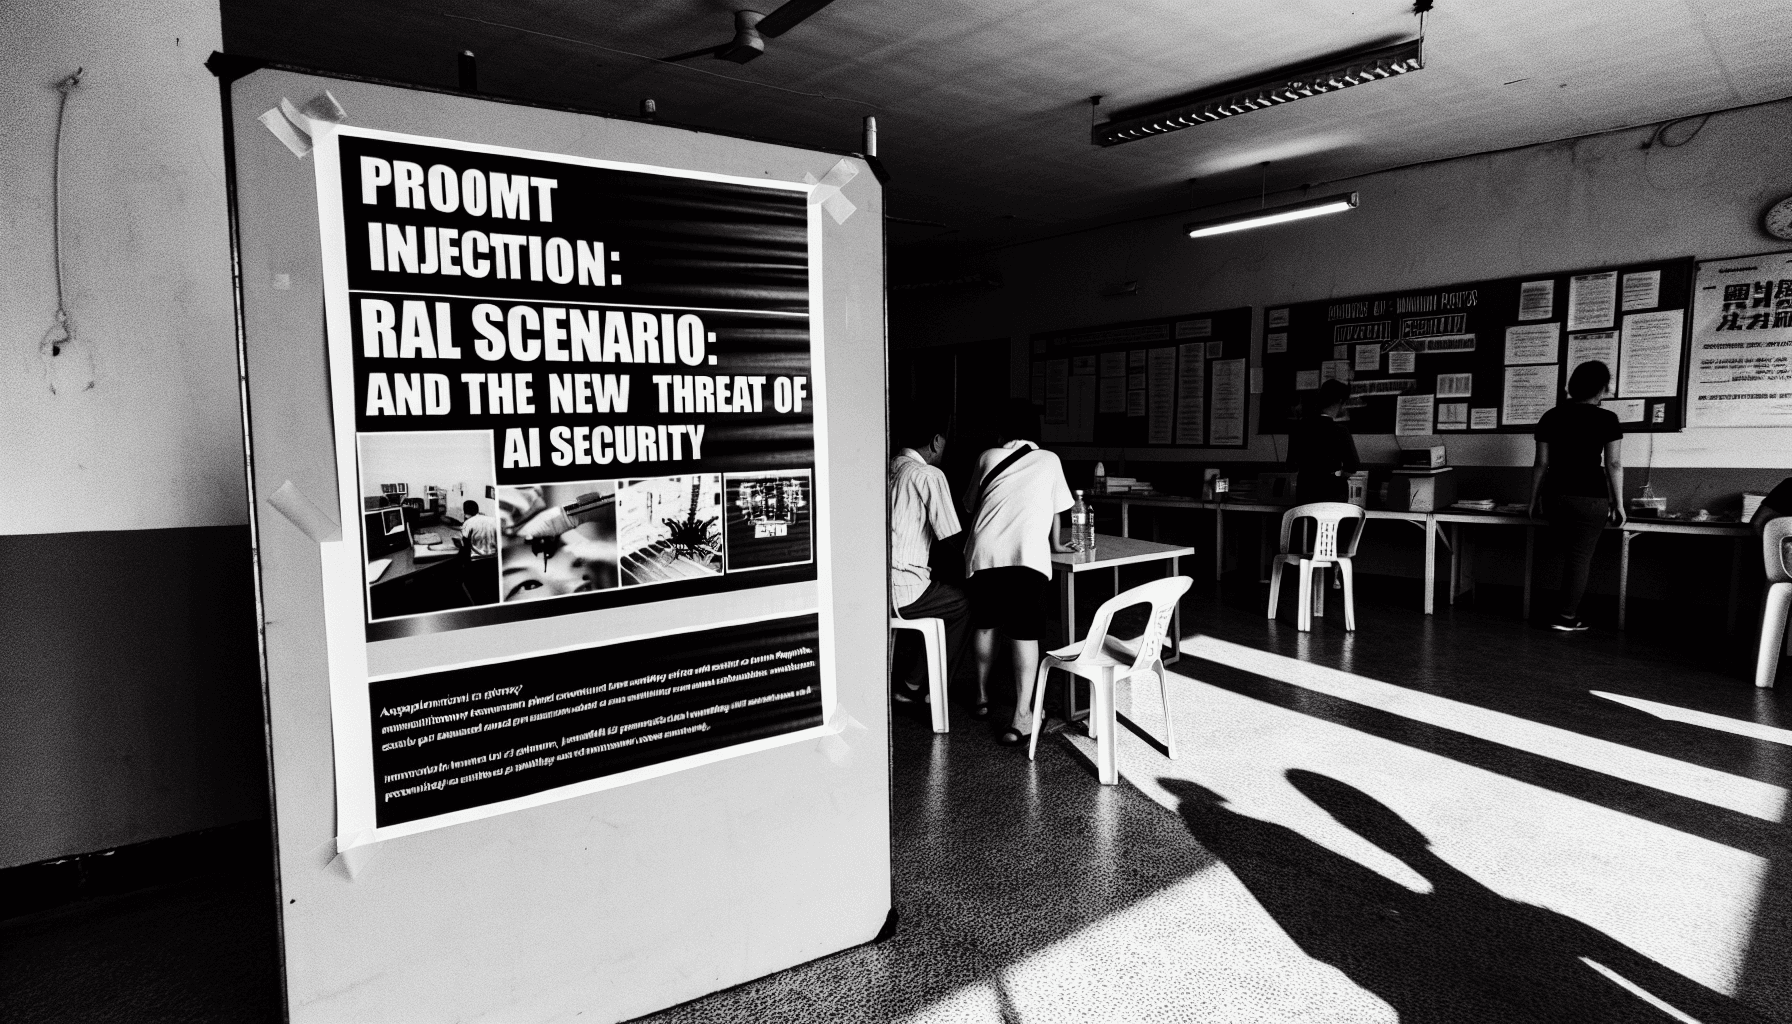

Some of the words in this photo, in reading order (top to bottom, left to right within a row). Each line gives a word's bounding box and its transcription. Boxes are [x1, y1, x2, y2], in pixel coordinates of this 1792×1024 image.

[361, 155, 557, 222] PROOMT
[361, 299, 461, 359] RAL
[472, 303, 718, 366] SCENARIO:
[366, 373, 450, 415] AND
[461, 373, 535, 414] THE
[549, 374, 629, 413] NEW
[653, 375, 765, 413] THREAT
[774, 377, 806, 413] OF
[503, 428, 540, 468] AI
[550, 425, 704, 466] SECURITY
